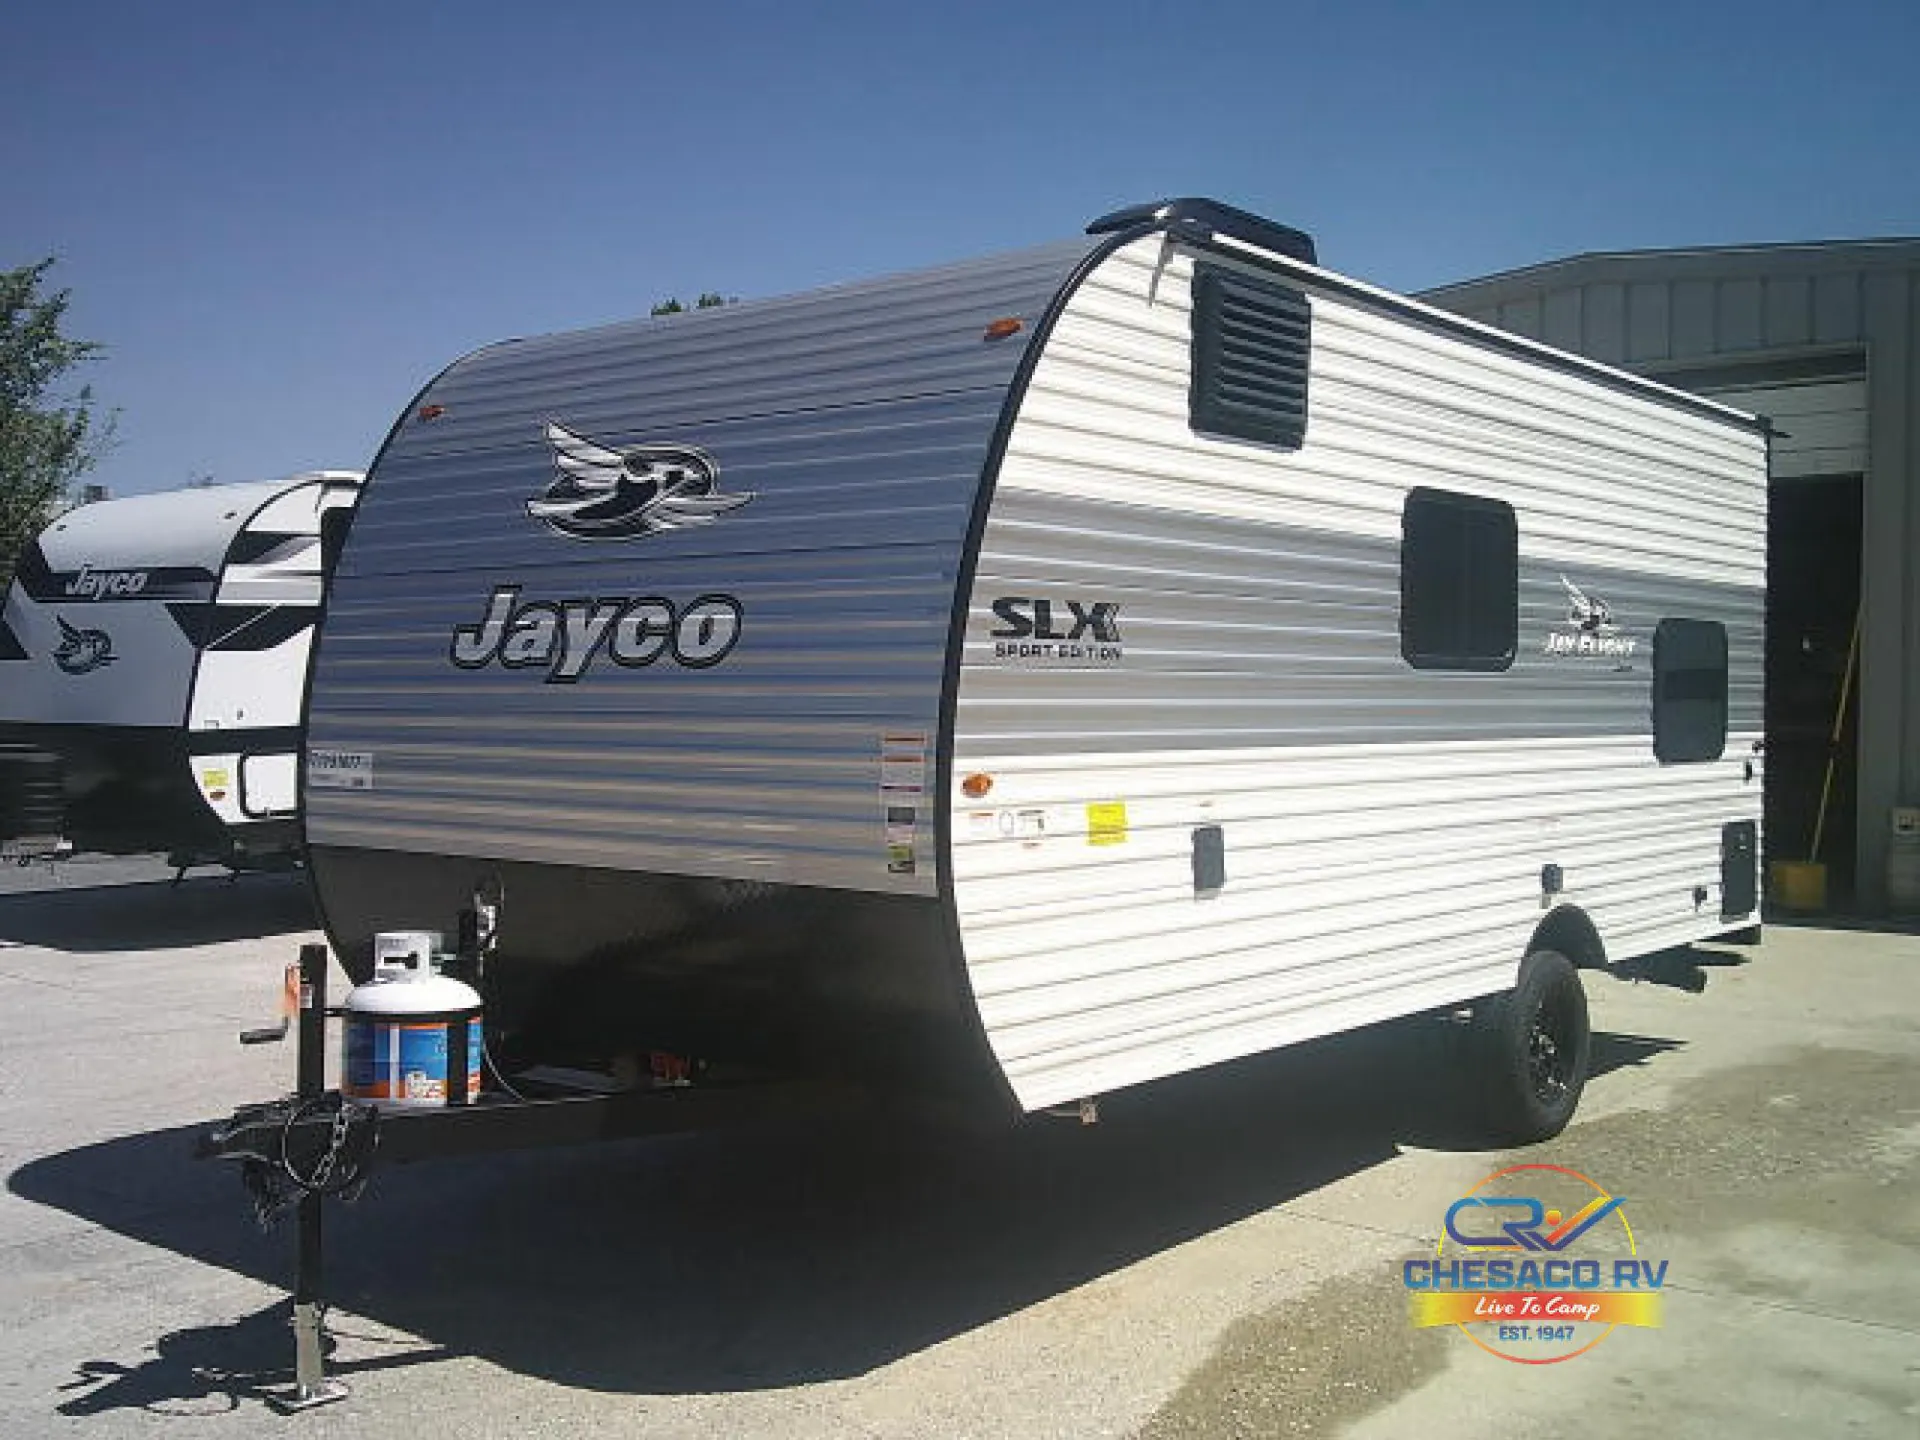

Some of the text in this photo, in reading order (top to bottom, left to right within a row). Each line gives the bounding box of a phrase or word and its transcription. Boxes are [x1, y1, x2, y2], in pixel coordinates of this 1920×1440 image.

[65, 564, 148, 600] Jayco
[450, 584, 744, 684] Jayco
[990, 597, 1121, 642] SLX
[995, 643, 1121, 660] SPORT EDITION
